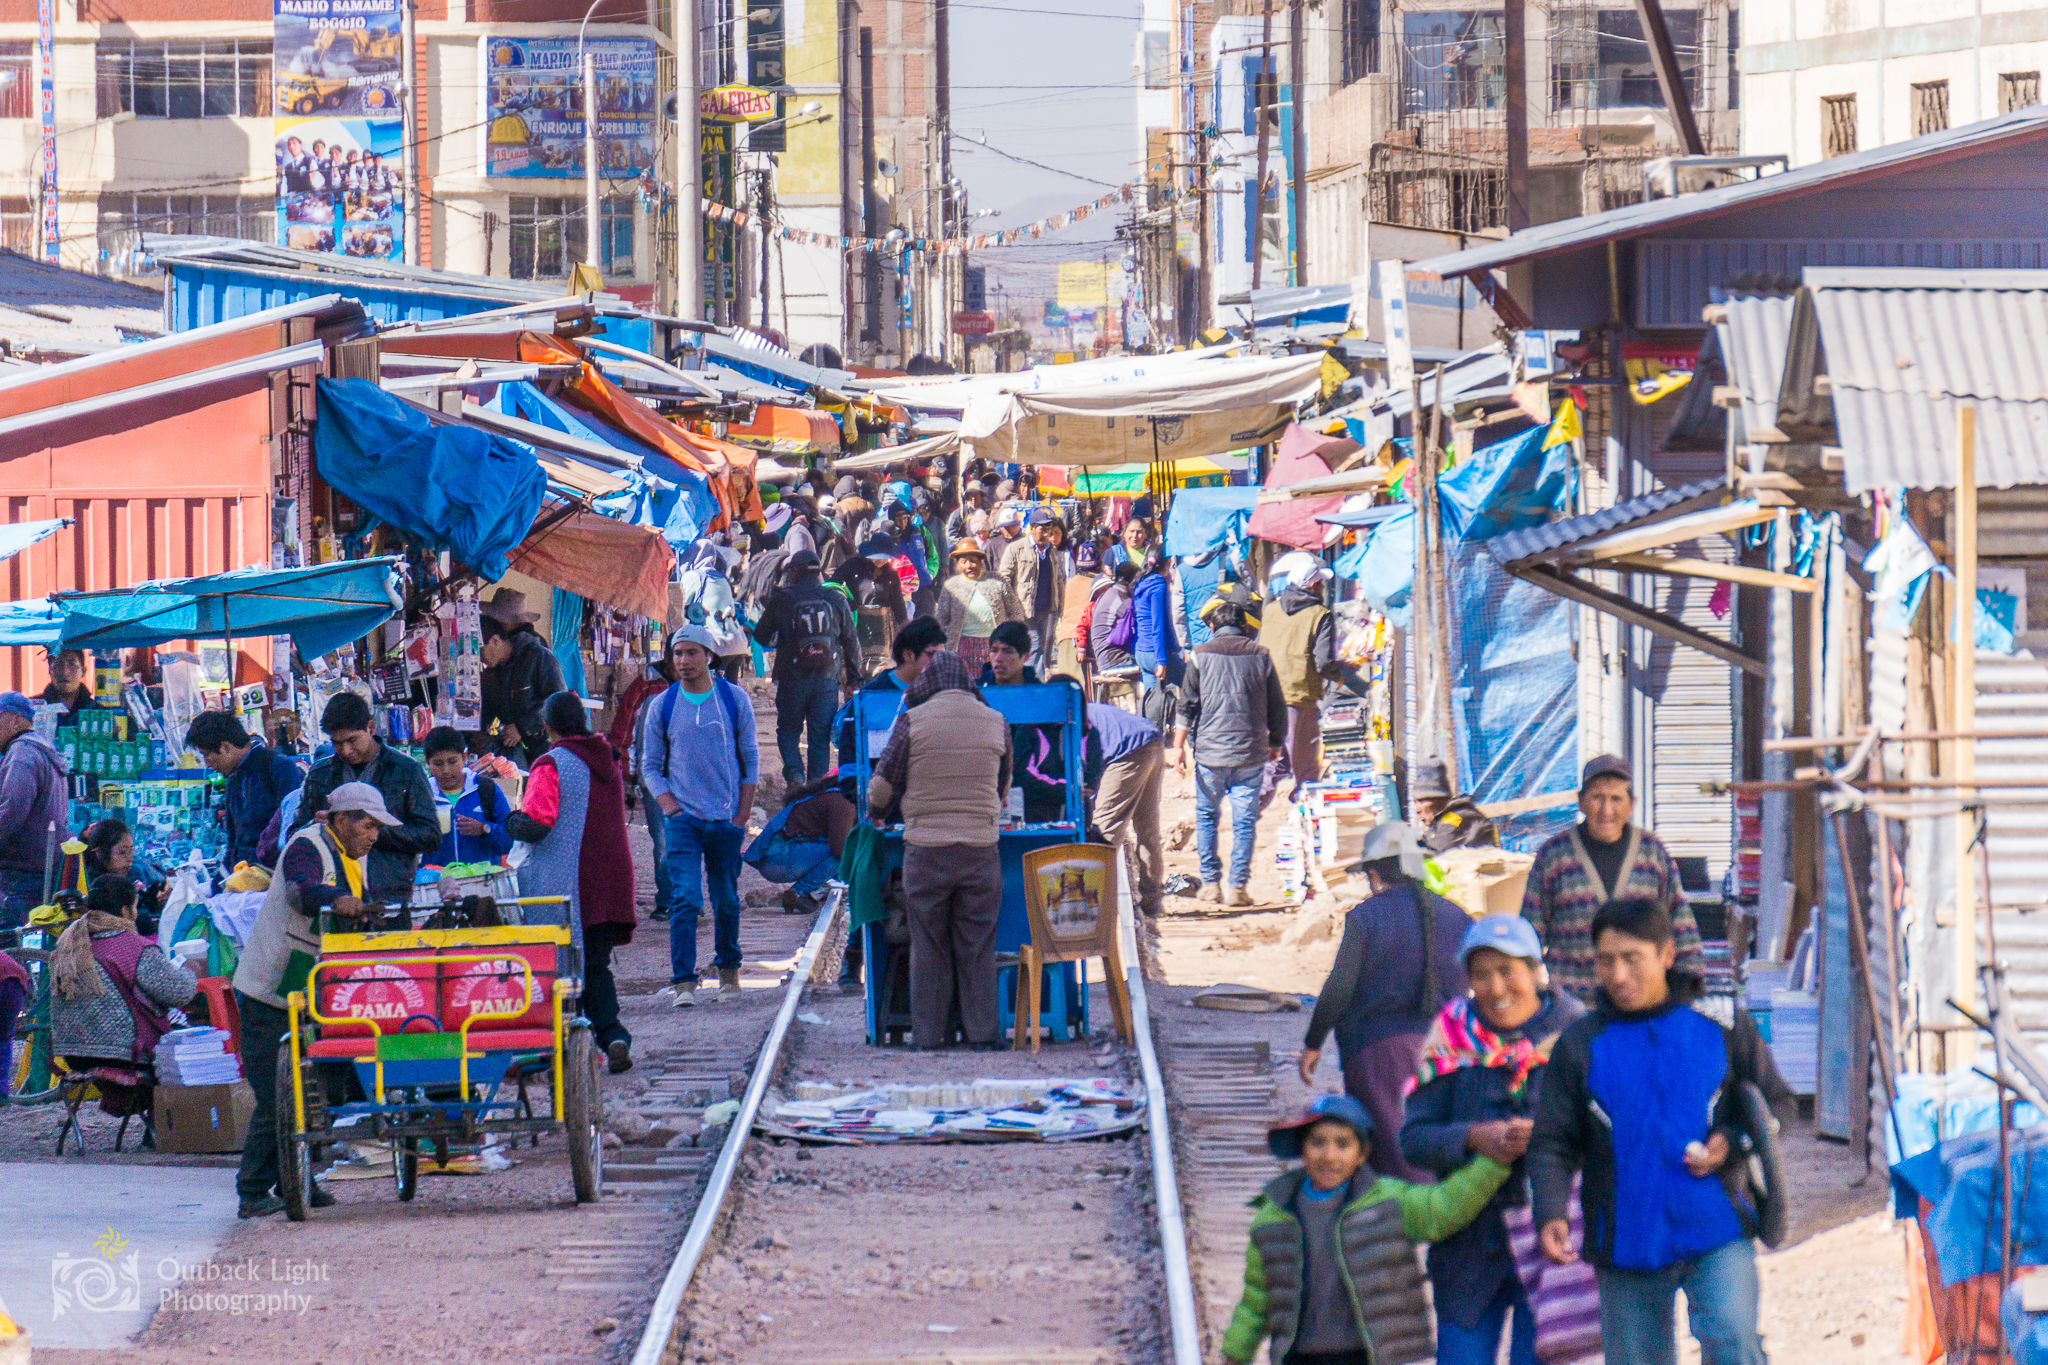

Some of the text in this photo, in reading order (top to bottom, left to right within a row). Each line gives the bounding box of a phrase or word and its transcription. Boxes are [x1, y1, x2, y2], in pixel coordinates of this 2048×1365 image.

[280, 0, 395, 13] MARIO SAMAME
[308, 16, 366, 30] BOGGIO
[530, 51, 652, 72] MARIO SAME BOGGIO
[700, 91, 772, 116] GALERIAS
[532, 121, 582, 134] ENRIQUE
[495, 149, 507, 162] 19
[350, 1002, 408, 1020] FAMA
[469, 998, 527, 1017] FAMA
